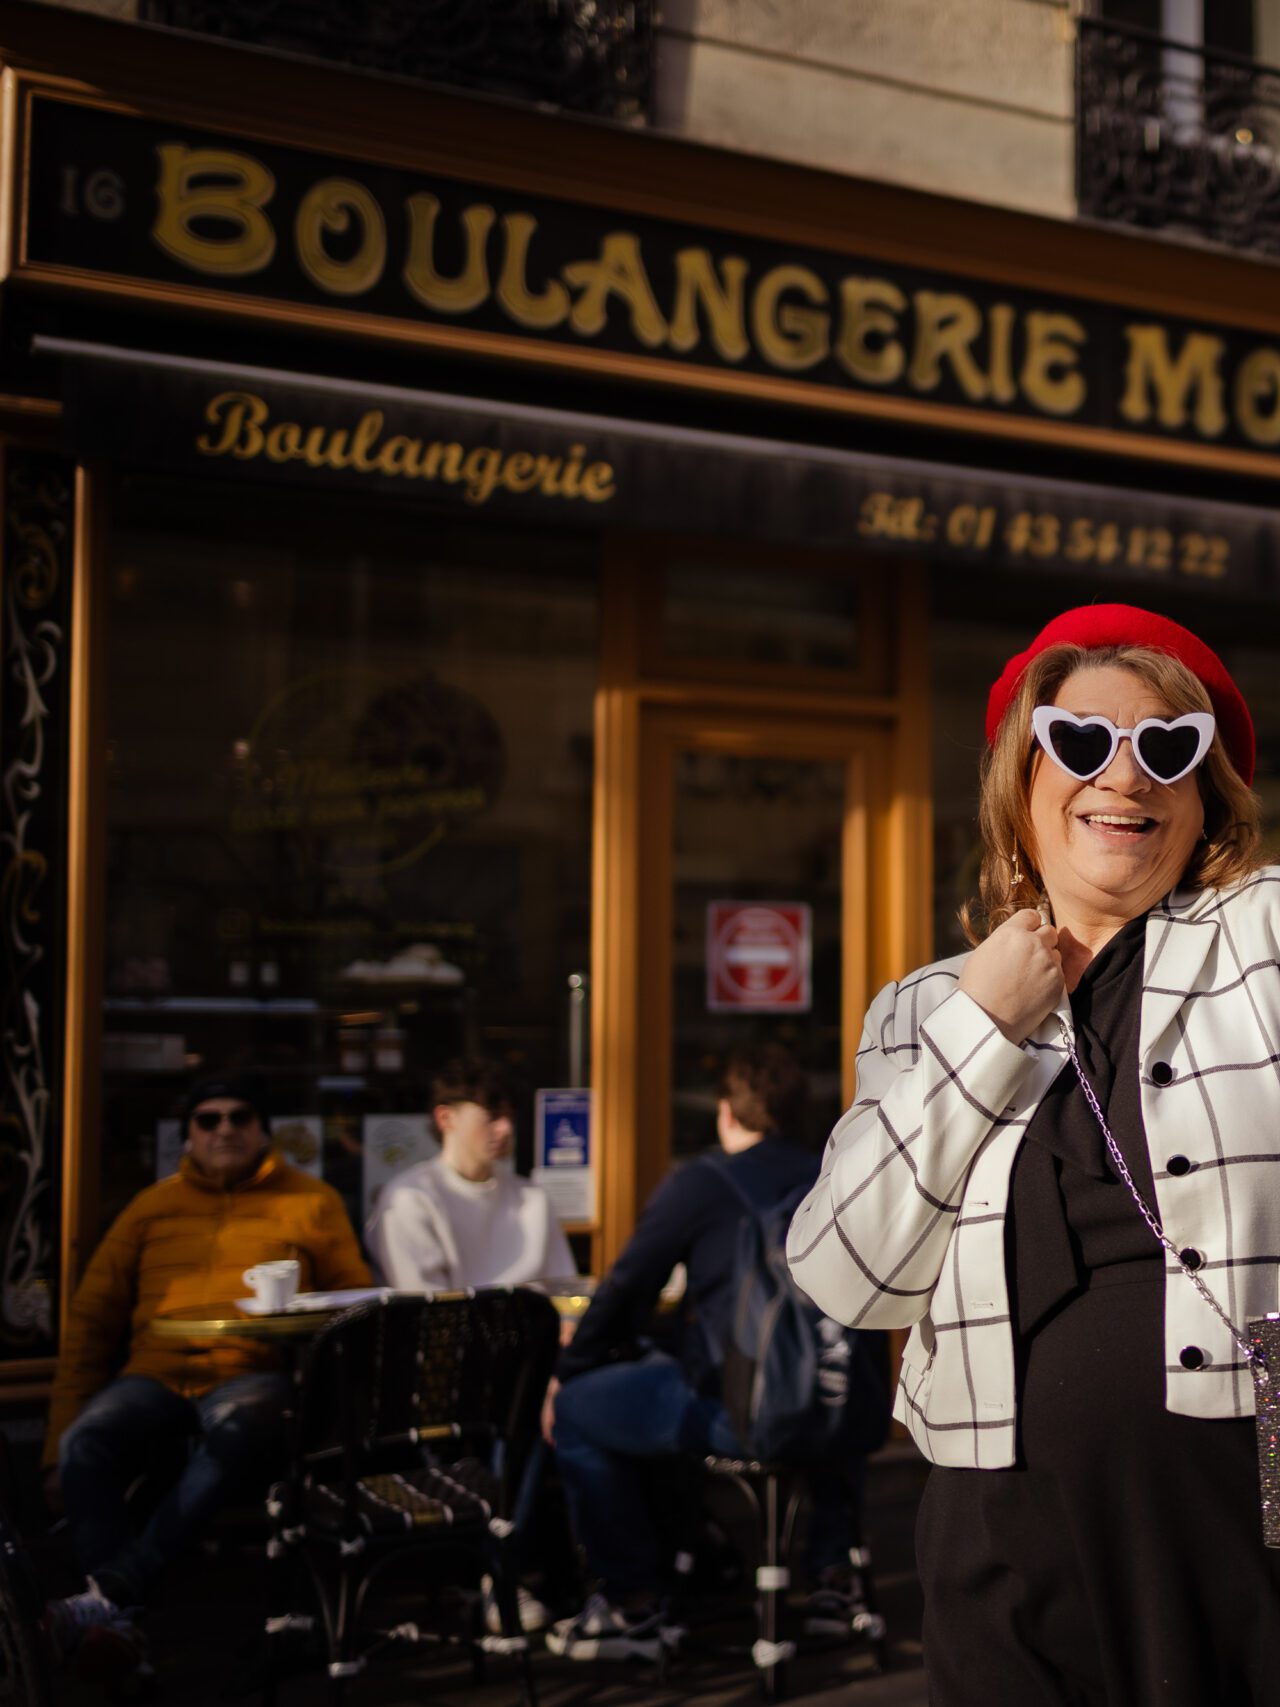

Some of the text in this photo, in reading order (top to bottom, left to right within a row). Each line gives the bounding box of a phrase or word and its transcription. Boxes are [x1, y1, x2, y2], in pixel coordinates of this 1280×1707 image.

[60, 167, 127, 222] 16
[153, 143, 1087, 414] BOULANGERIE
[197, 394, 615, 503] Boulangerie
[947, 504, 997, 549] 01
